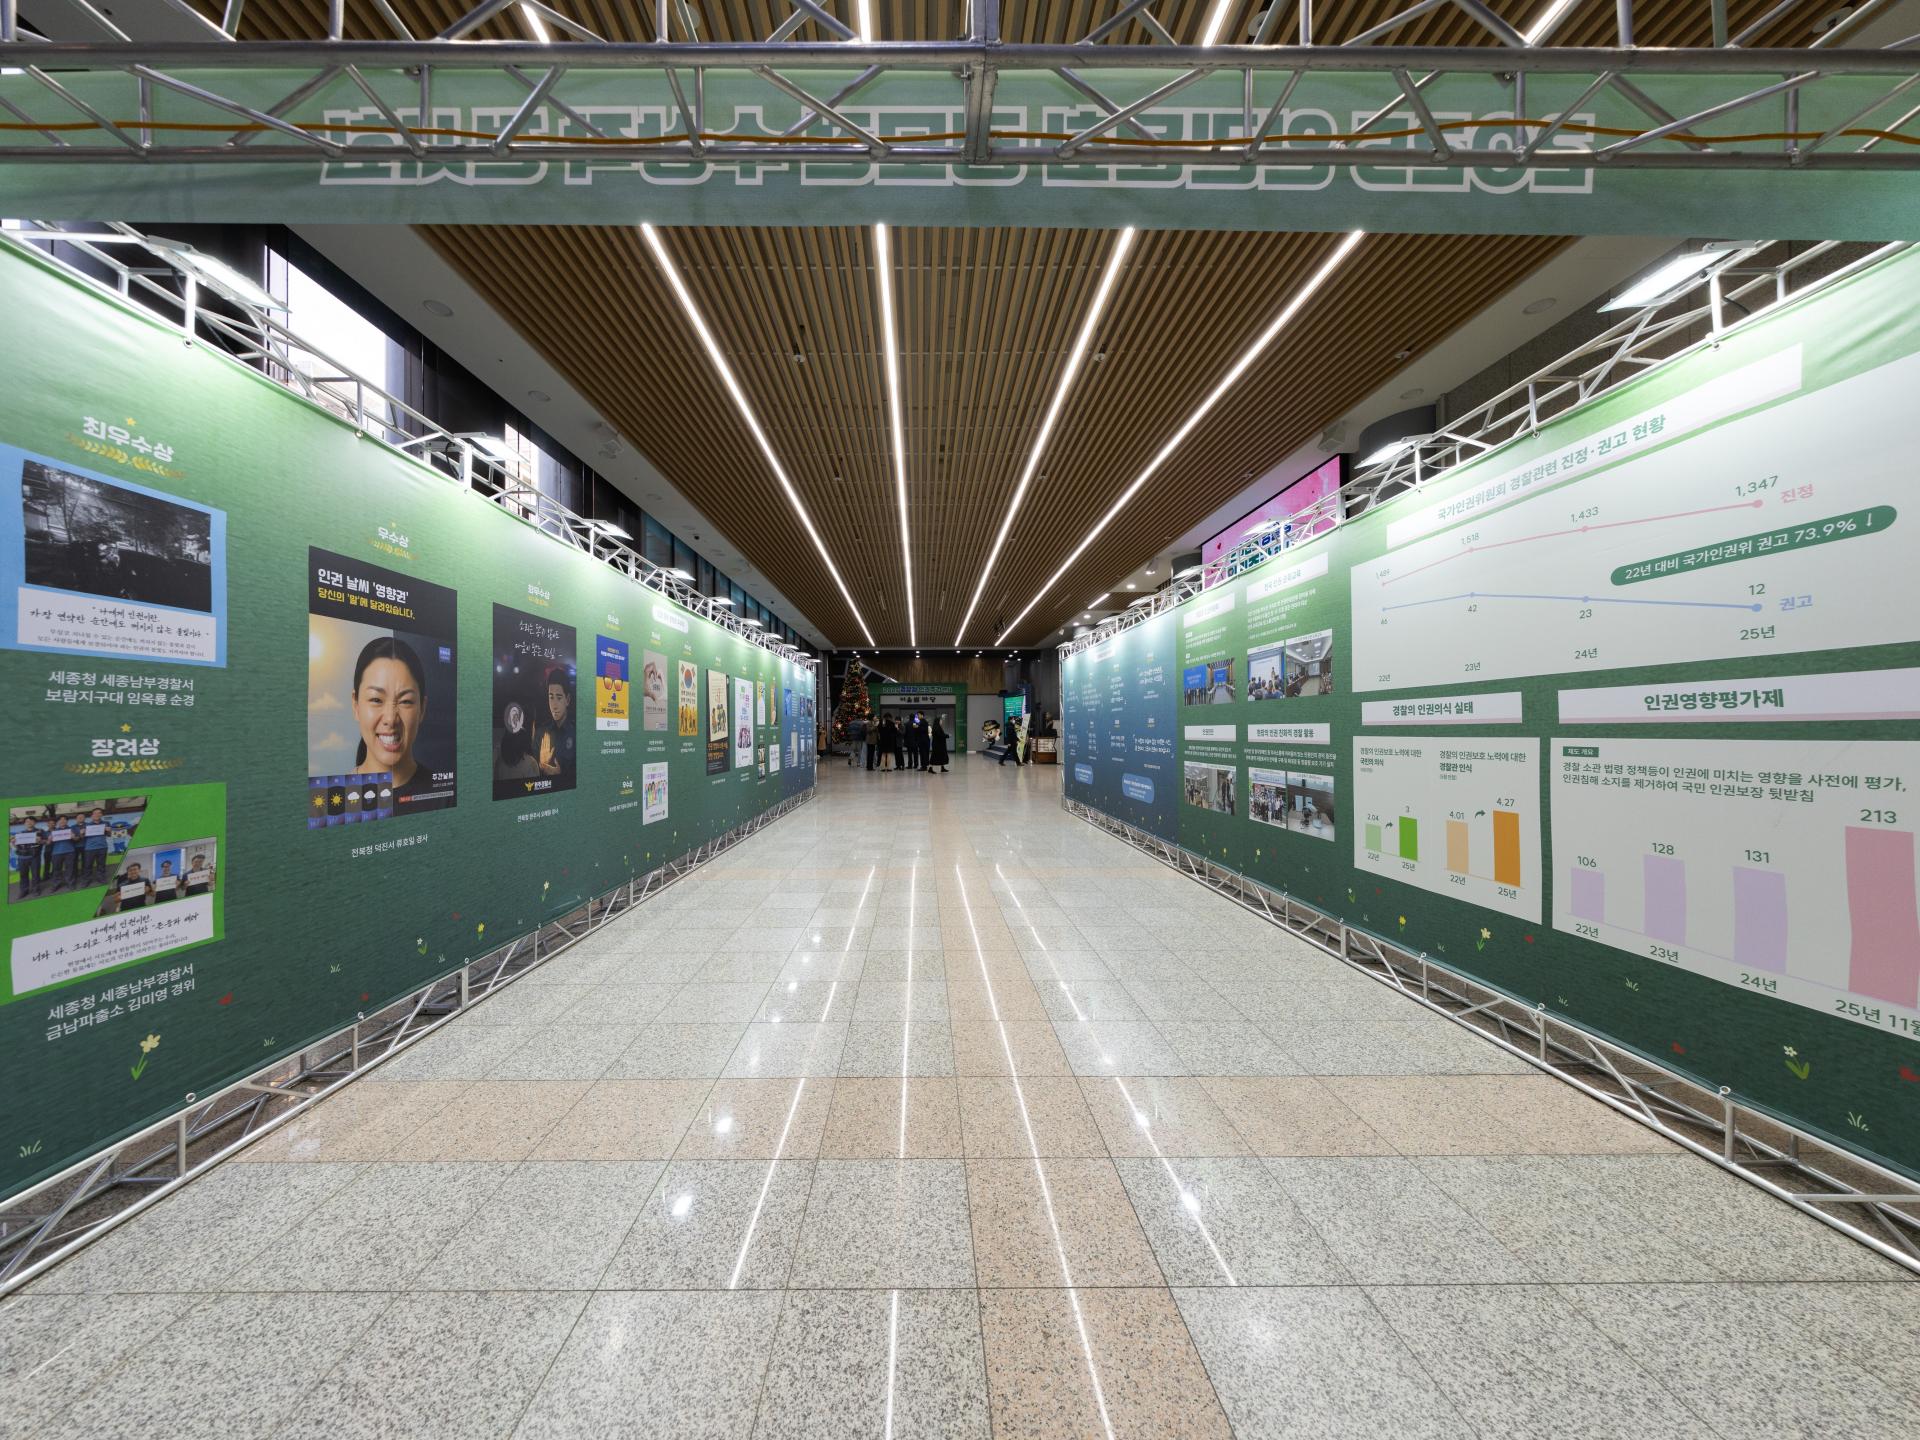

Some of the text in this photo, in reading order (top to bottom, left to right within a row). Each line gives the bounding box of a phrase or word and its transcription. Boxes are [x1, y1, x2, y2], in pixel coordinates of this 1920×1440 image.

[82, 416, 175, 463] 최우수상
[1437, 484, 1507, 521] 국가인권위원회
[1509, 460, 1558, 494] 경찰관련
[1632, 414, 1666, 441] 현황
[1735, 475, 1779, 497] 1,347
[1779, 483, 1815, 504] 진정
[1570, 506, 1599, 524] 1,433
[378, 526, 410, 548] 우수상
[1624, 519, 1857, 580] 22년 대비 국가인권위 권고 73.9%
[318, 568, 343, 588] 인권
[346, 575, 370, 594] 날씨
[1748, 583, 1766, 596] 12
[317, 586, 345, 603] 당신의
[369, 598, 416, 621] 달려있습니다.
[1467, 605, 1478, 613] 42
[1779, 594, 1813, 612] 권고
[1579, 608, 1593, 620] 23
[1739, 625, 1776, 641] 25년
[1574, 647, 1598, 660] 24년
[1464, 662, 1481, 672] 23년
[48, 671, 195, 691] 세종청 세종남부경찰서
[44, 688, 124, 705] 보람지구대
[170, 693, 196, 707] 순경
[1643, 688, 1785, 711] 인권영향평가제
[1392, 701, 1474, 717] 경찰의 인권의식 실태
[91, 738, 161, 757] 장려상
[1439, 750, 1526, 763] 경찰의 인권보호 노력에 대한
[1439, 762, 1458, 773] 경찰관
[1562, 761, 1907, 793] 경찰 소관 법령 정책등이 인권에 미치는 영향을 사전에 평가,
[1562, 773, 1815, 803] 인권침해 소지를 제거하여 국민 인권보장 뒷받침
[1496, 797, 1515, 808] 4.27
[1449, 811, 1465, 821] 4.01
[1859, 808, 1897, 825] 213
[1367, 852, 1380, 862] 22년
[1651, 842, 1675, 856] 128
[1744, 849, 1770, 864] 131
[1401, 862, 1416, 872] 25년
[1577, 855, 1597, 868] 106
[1450, 874, 1466, 886] 22년
[1497, 886, 1517, 900] 25년
[1575, 923, 1599, 939] 22년
[1649, 945, 1679, 964] 23년
[47, 962, 195, 1022] 세종청 세종남부경찰서
[1740, 973, 1777, 994] 24년
[45, 976, 196, 1042] 금남파출소 김미영 경위
[1834, 999, 1881, 1024] 25년
